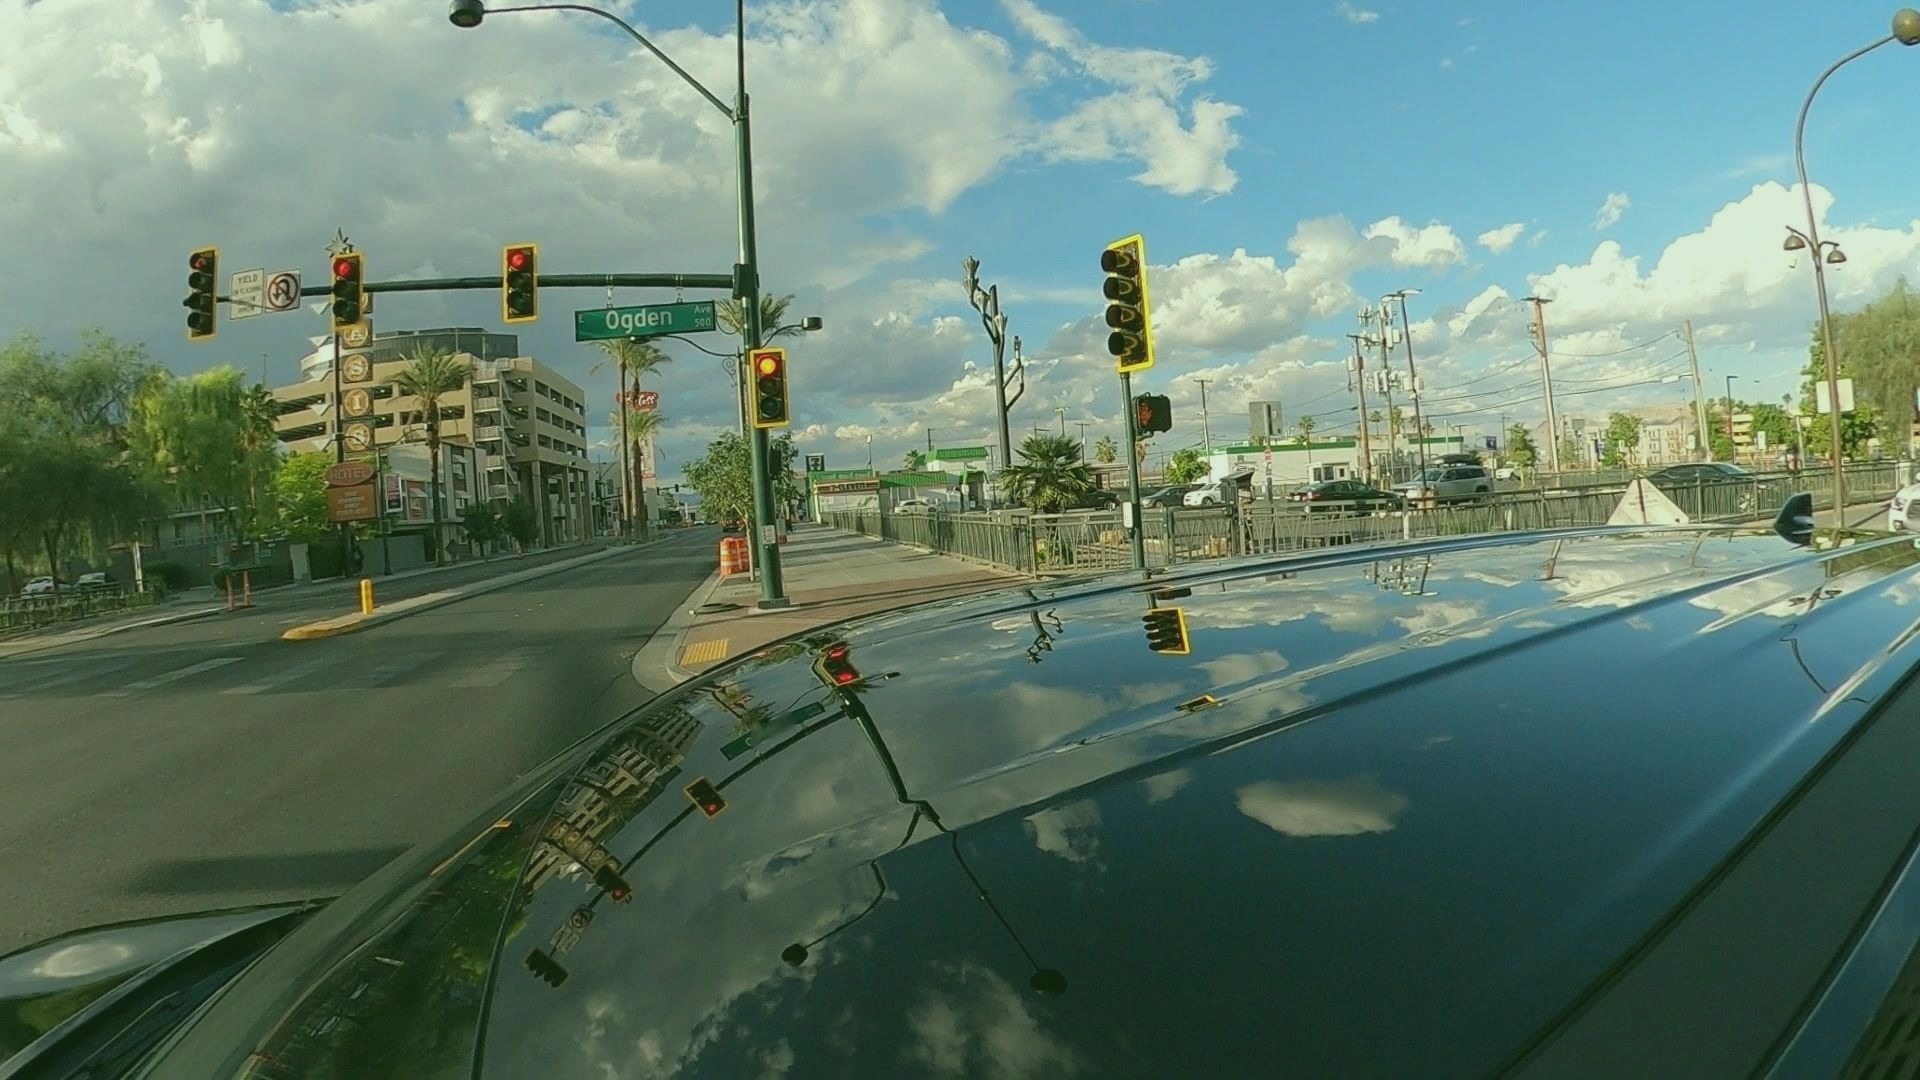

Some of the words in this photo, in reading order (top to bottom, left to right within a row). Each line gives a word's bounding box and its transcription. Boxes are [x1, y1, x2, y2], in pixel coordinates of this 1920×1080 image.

[238, 274, 258, 285] YIELD
[578, 313, 584, 324] E
[605, 308, 673, 334] Ogden
[694, 305, 712, 314] Ave
[694, 318, 712, 328] 500
[330, 468, 368, 480] HOTEL
